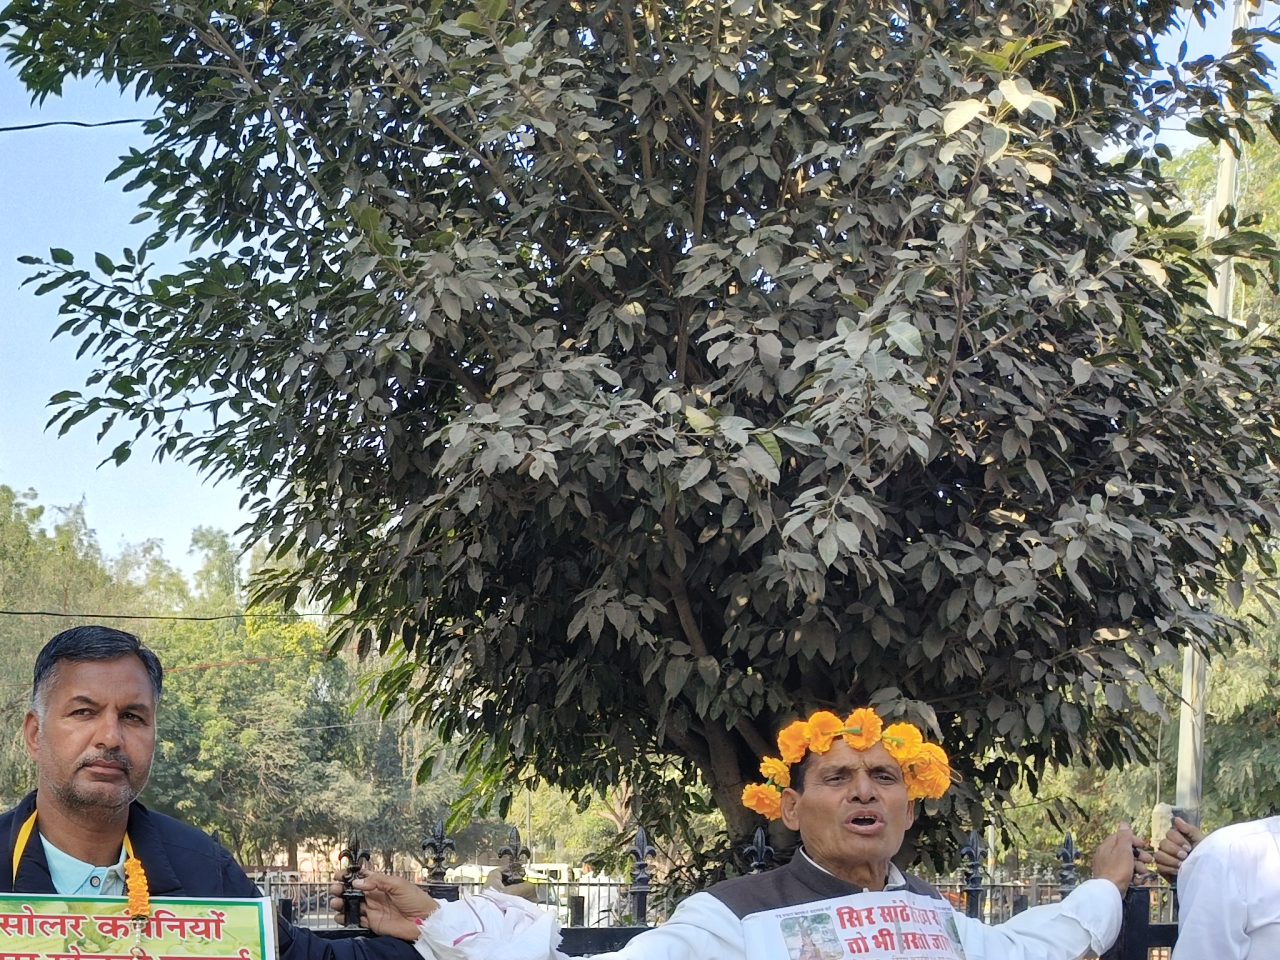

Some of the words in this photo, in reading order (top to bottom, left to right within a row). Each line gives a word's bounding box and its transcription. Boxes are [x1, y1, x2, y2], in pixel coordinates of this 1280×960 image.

[836, 906, 876, 929] सिर
[845, 931, 869, 953] तो
[872, 928, 895, 951] भी
